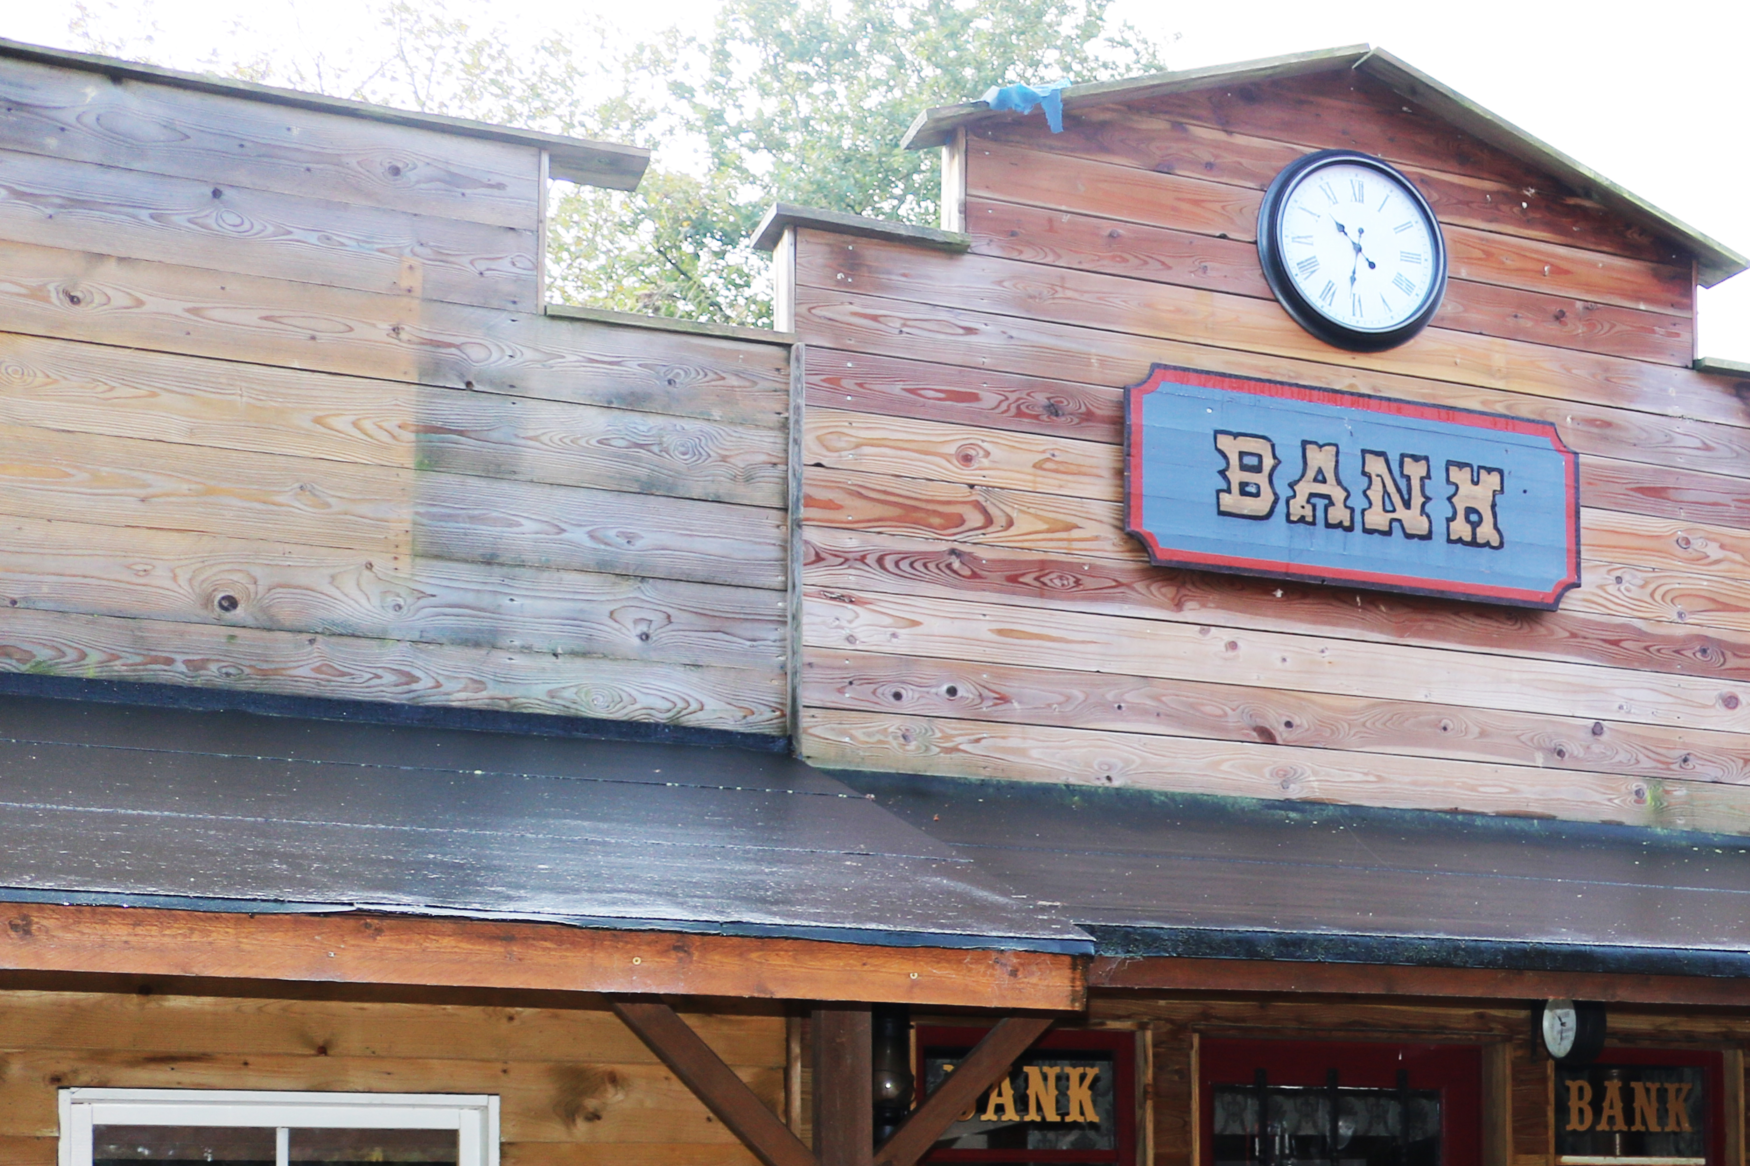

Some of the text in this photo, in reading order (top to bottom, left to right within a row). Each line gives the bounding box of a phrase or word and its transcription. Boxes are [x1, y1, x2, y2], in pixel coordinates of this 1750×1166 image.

[1213, 430, 1504, 550] BANK
[943, 1064, 1099, 1122] ANK
[1565, 1079, 1693, 1132] BANK
